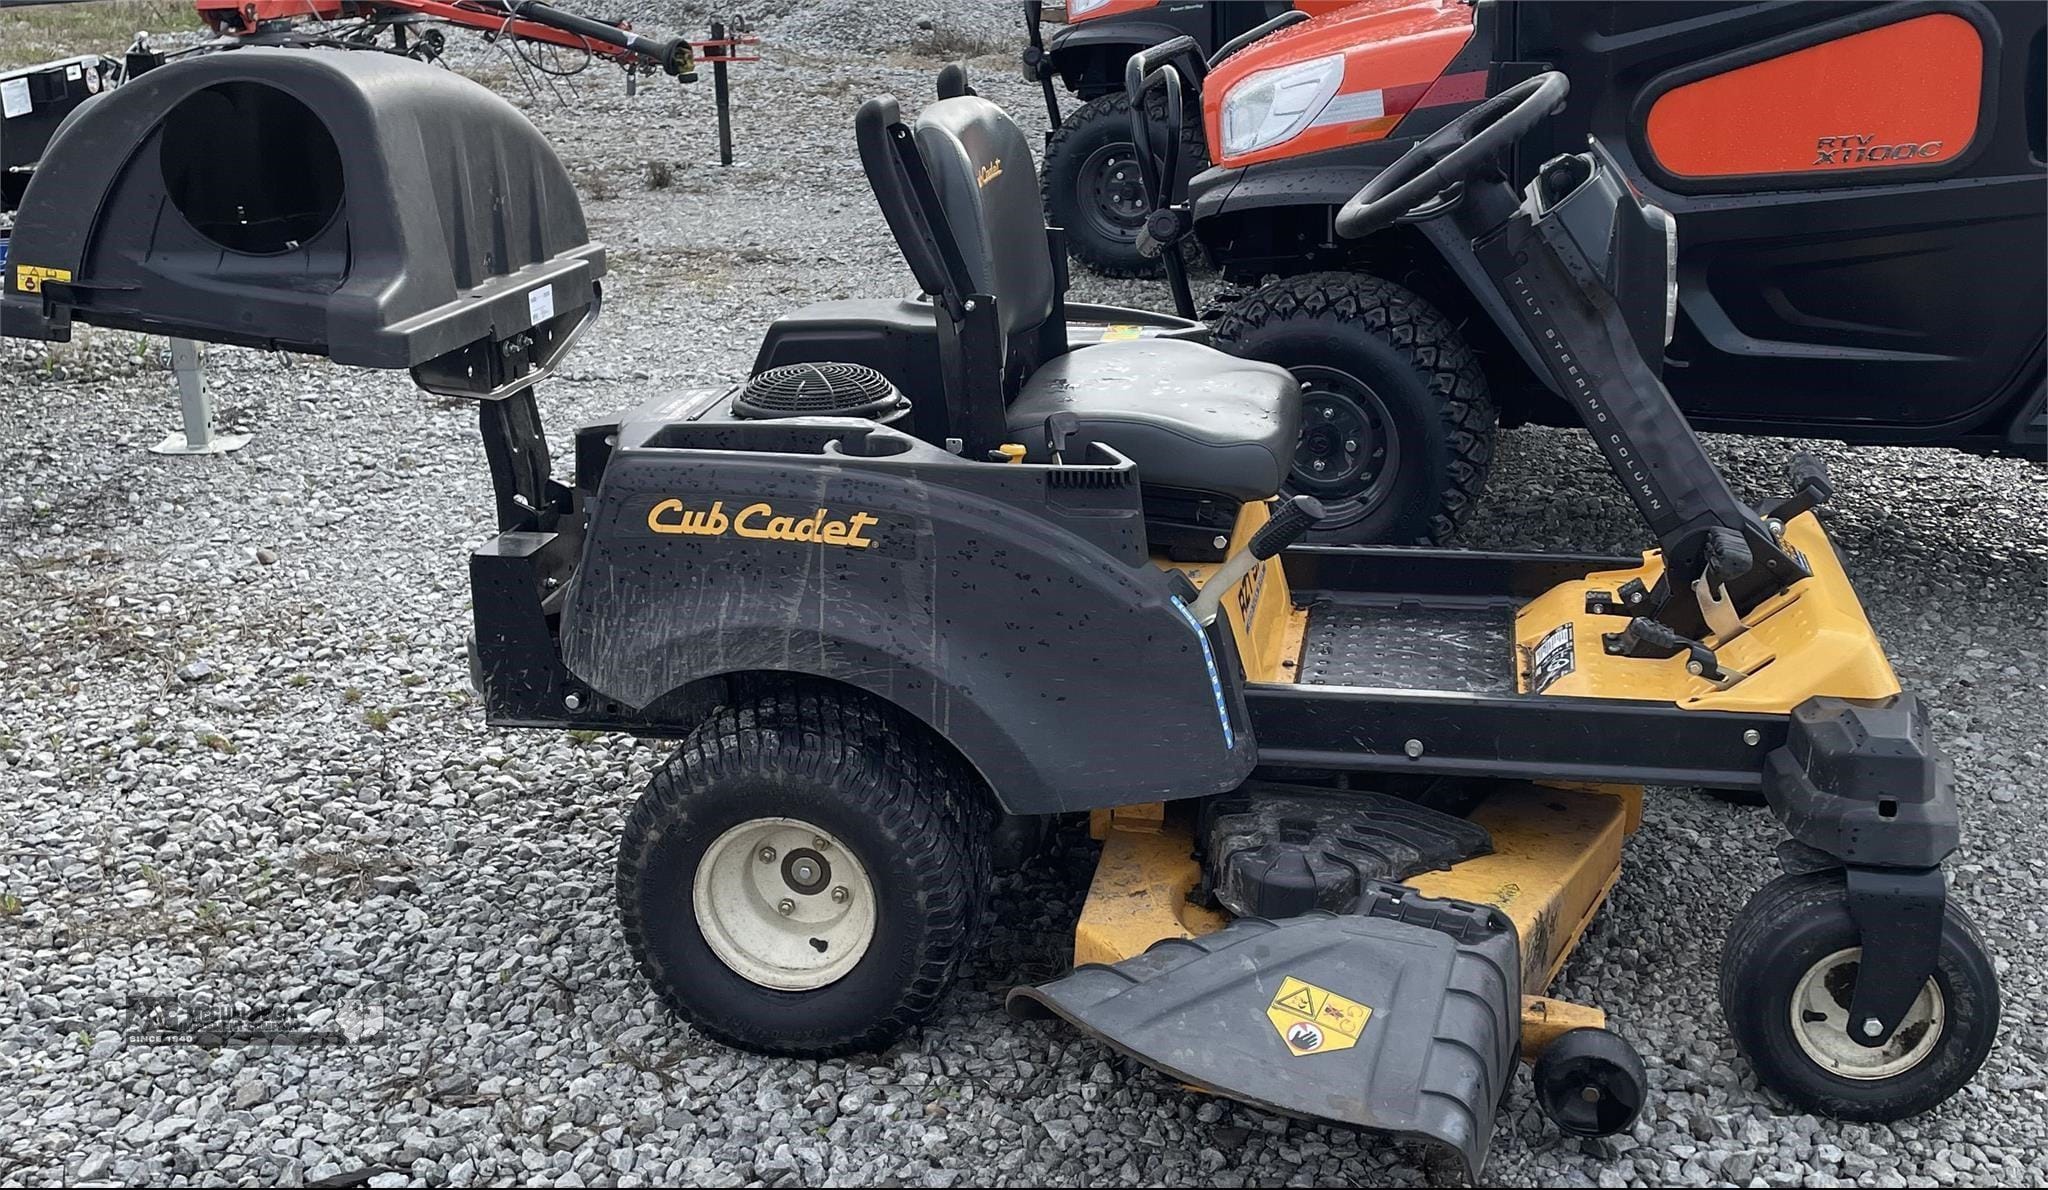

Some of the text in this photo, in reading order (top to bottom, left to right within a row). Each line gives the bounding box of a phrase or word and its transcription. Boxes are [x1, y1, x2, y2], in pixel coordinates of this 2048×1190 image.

[1812, 140, 1943, 166] X1100C
[1817, 133, 1875, 149] RTV
[1514, 277, 1661, 510] TILT STEERING COLUMN
[647, 498, 879, 548] Cub Cadet
